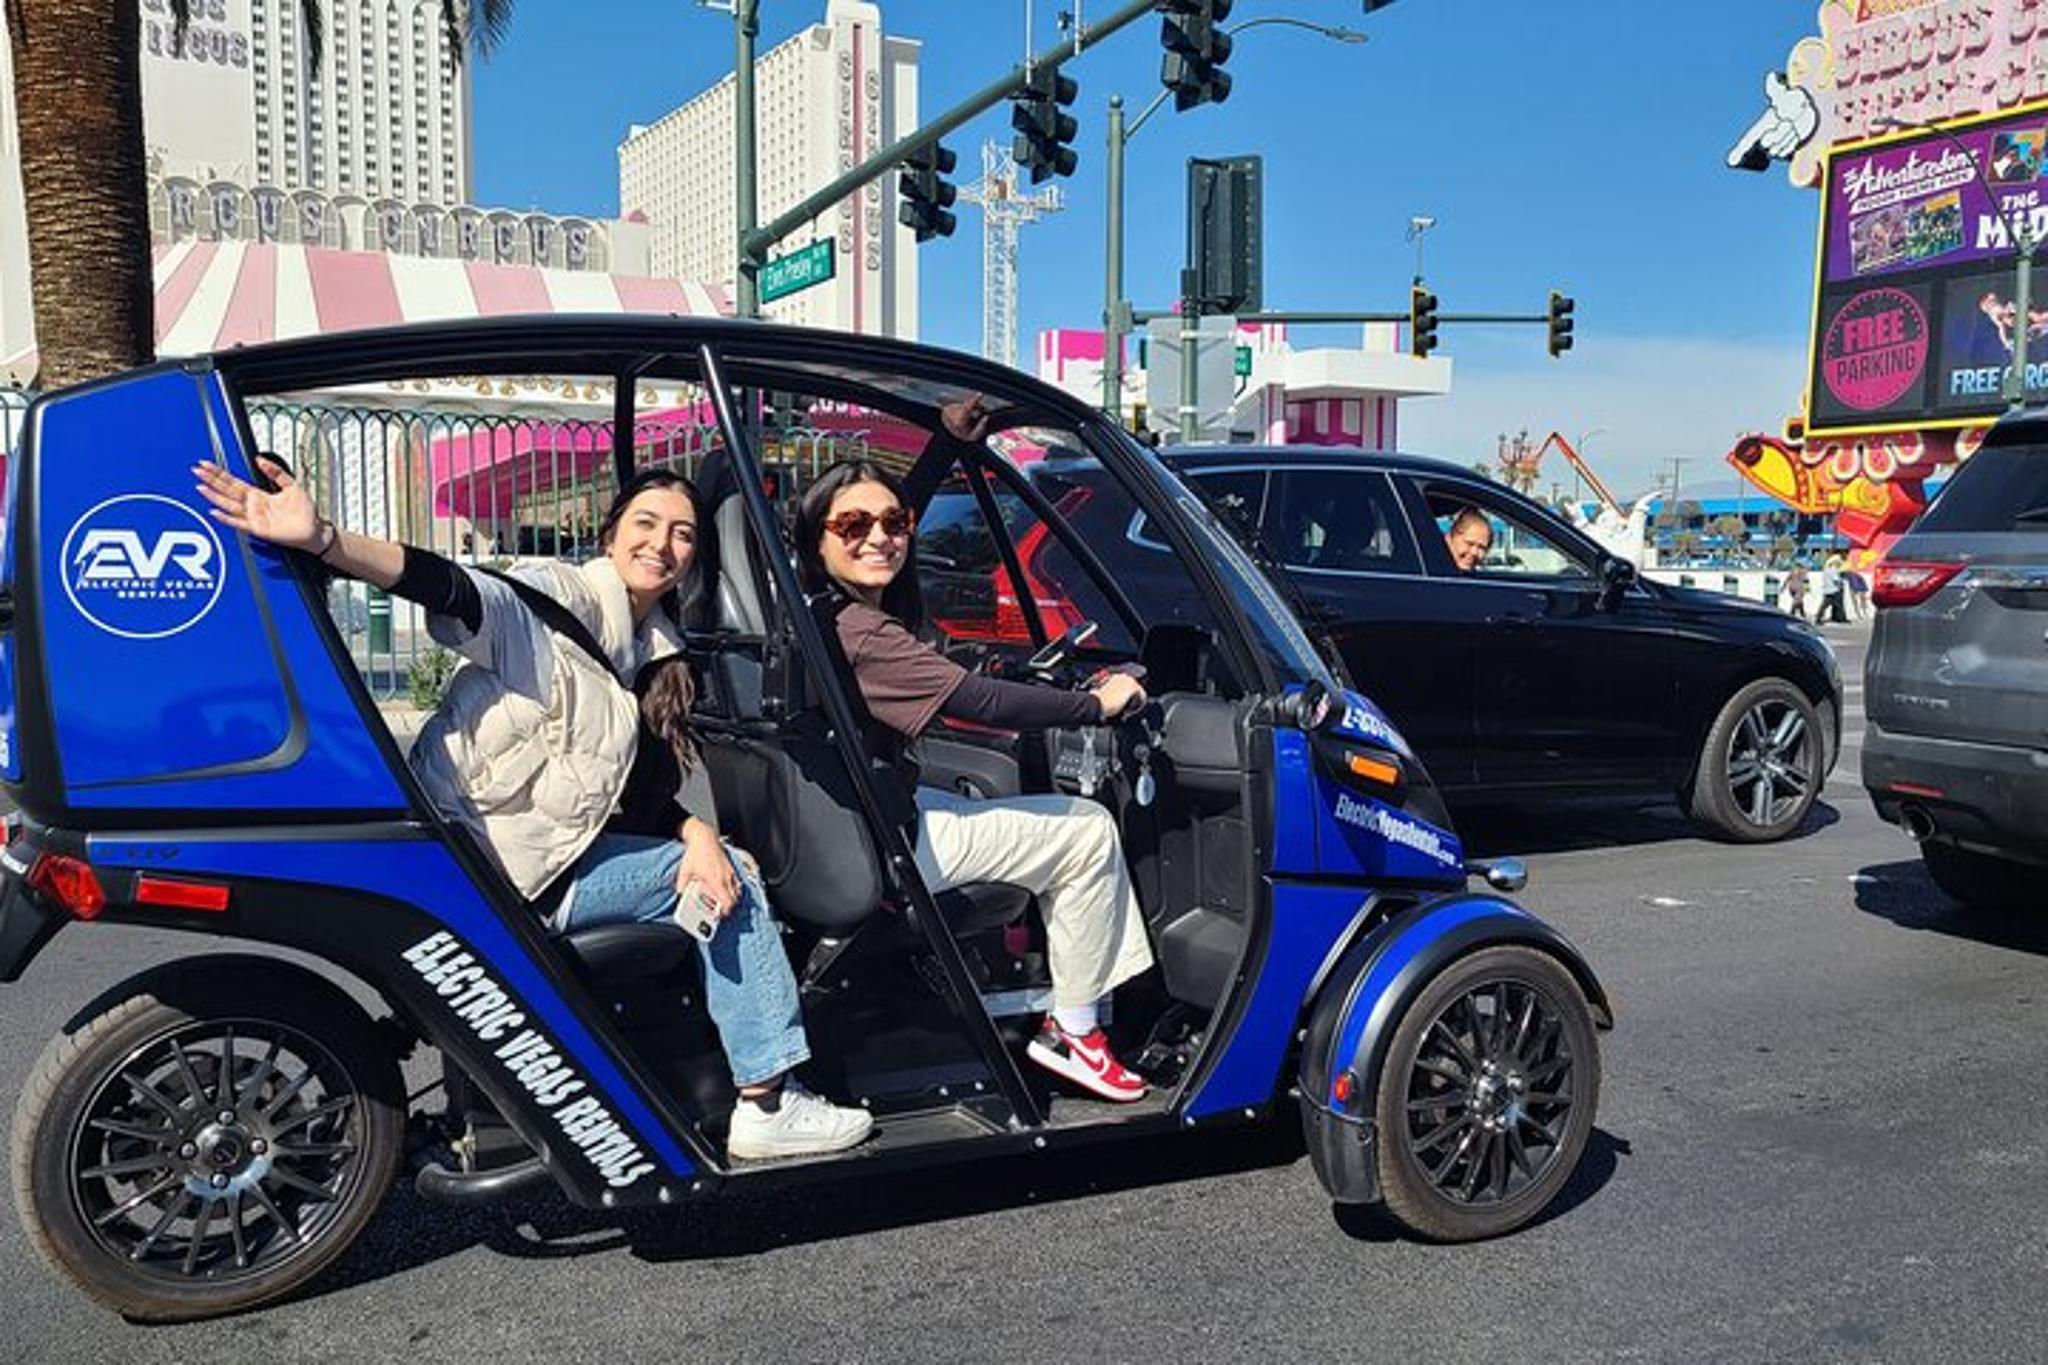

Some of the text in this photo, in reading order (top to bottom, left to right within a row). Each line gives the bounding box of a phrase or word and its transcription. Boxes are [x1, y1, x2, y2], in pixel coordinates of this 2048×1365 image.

[1842, 308, 1905, 352] FREE
[1836, 346, 1917, 387] PARKING
[1951, 366, 2000, 396] FREE
[74, 530, 213, 579] EVR
[82, 579, 215, 589] ELECTRIC VEGAS
[117, 590, 187, 599] RENTALS
[401, 929, 656, 1188] ELECTRIC VEGAS RENTALS
